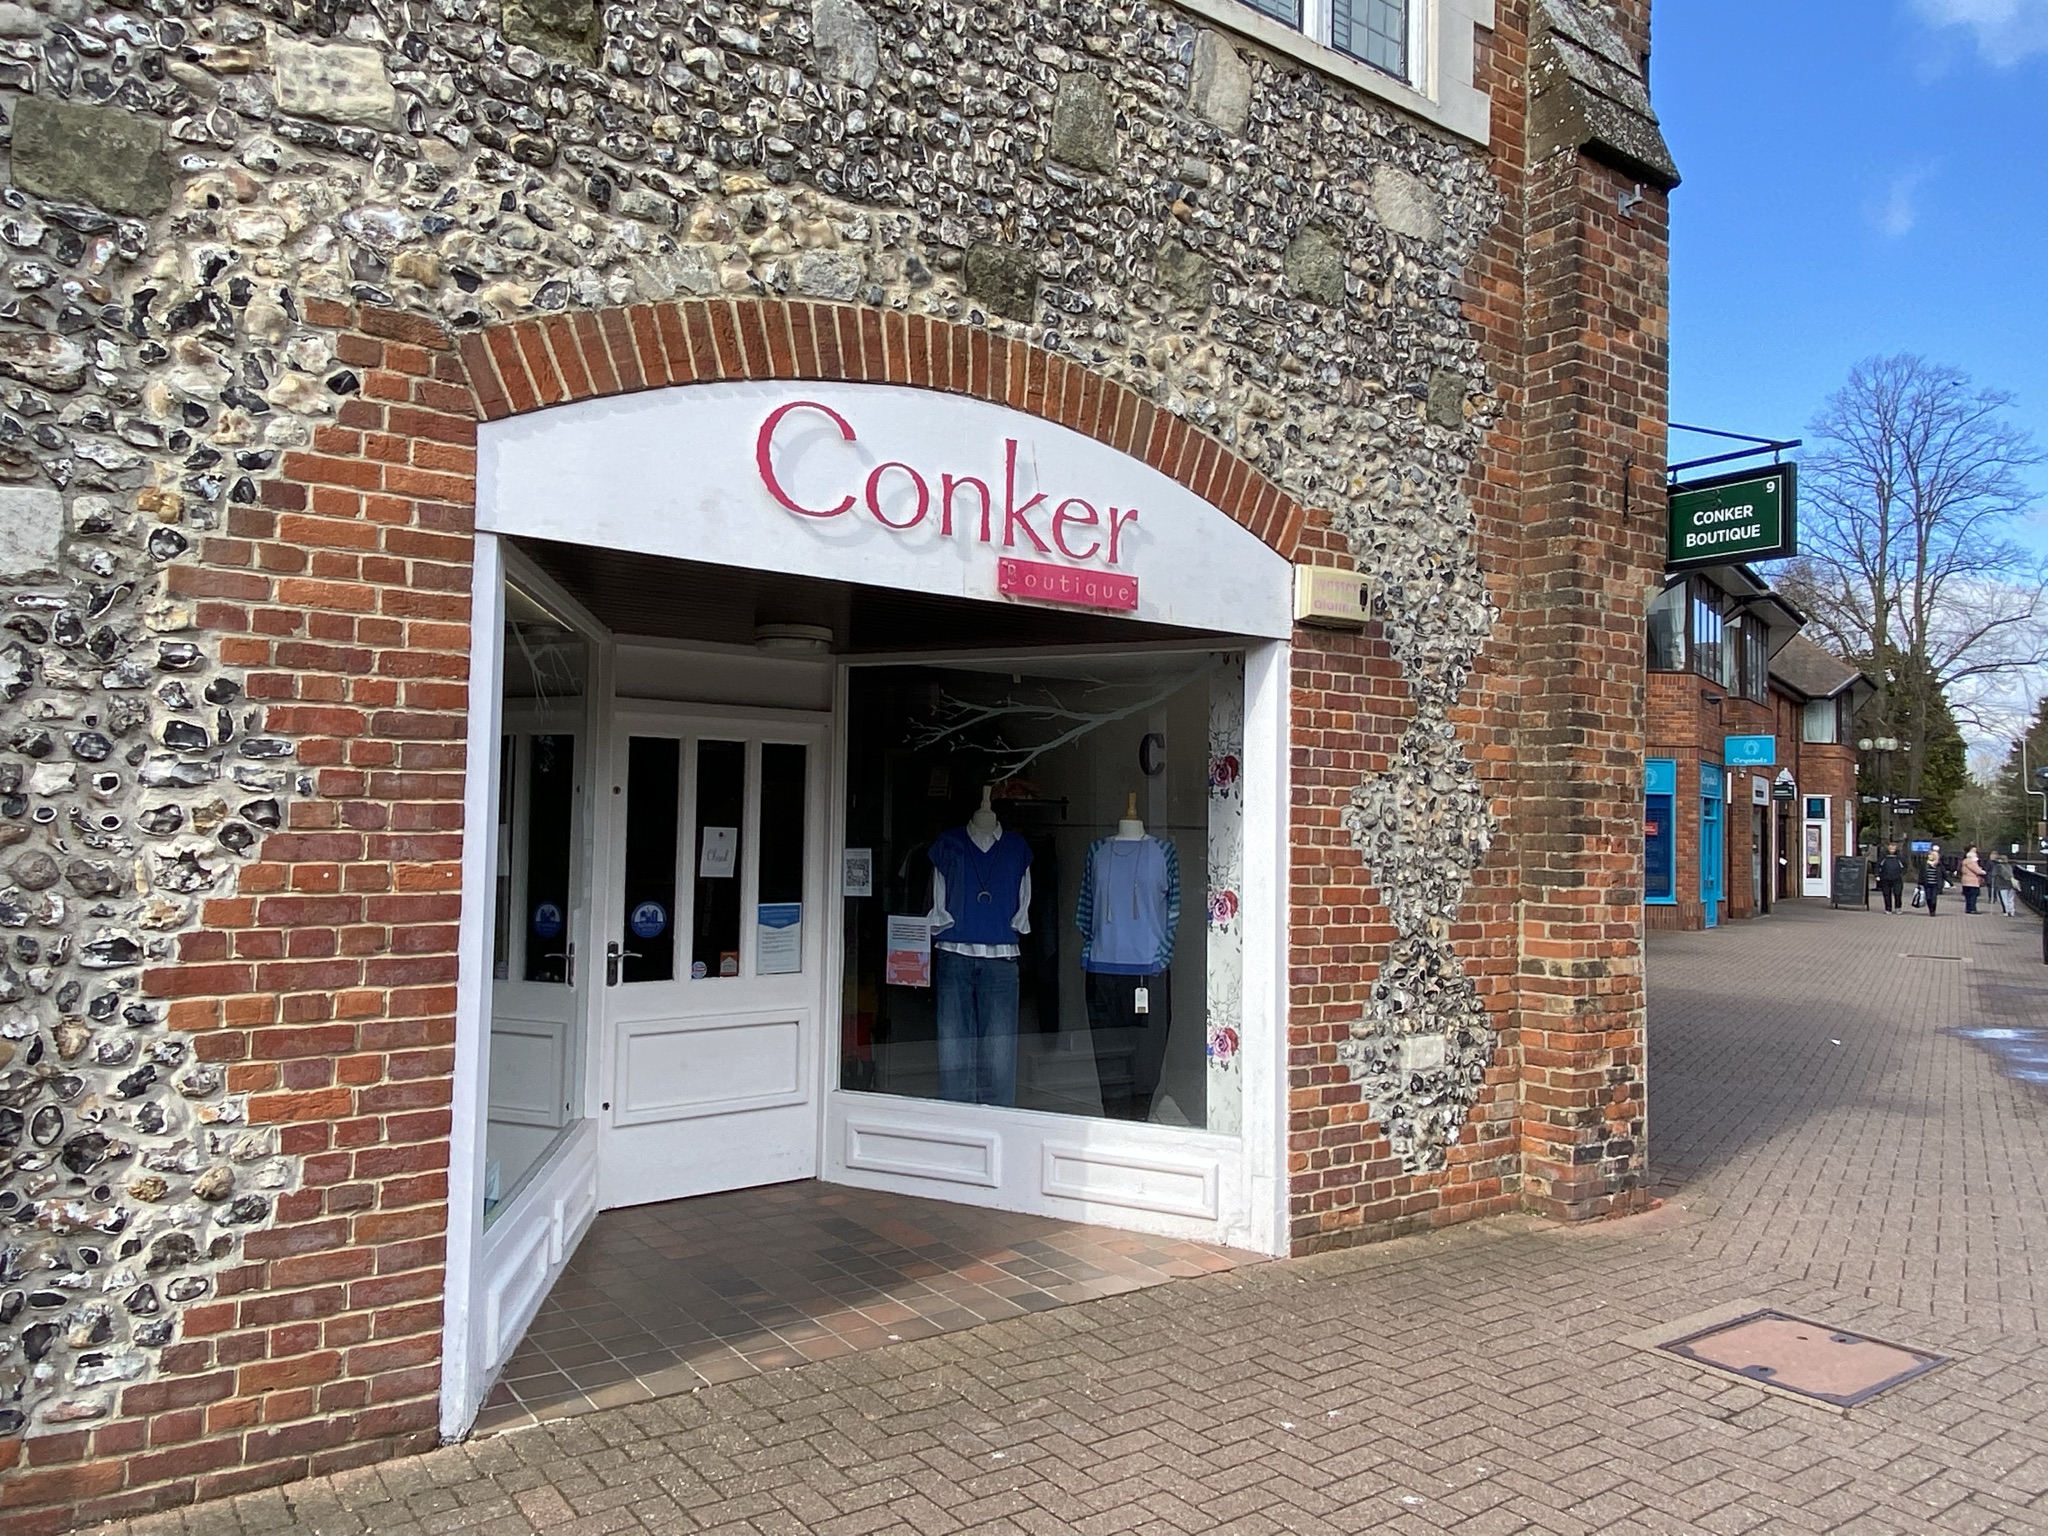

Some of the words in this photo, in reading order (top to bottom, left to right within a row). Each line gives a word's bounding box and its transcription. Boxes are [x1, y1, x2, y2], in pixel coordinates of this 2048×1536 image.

[756, 401, 1138, 564] Conker
[1766, 481, 1775, 493] 9
[1693, 505, 1753, 526] CONKER
[1686, 524, 1761, 548] BOUTIQUE
[1007, 564, 1129, 602] Boutique
